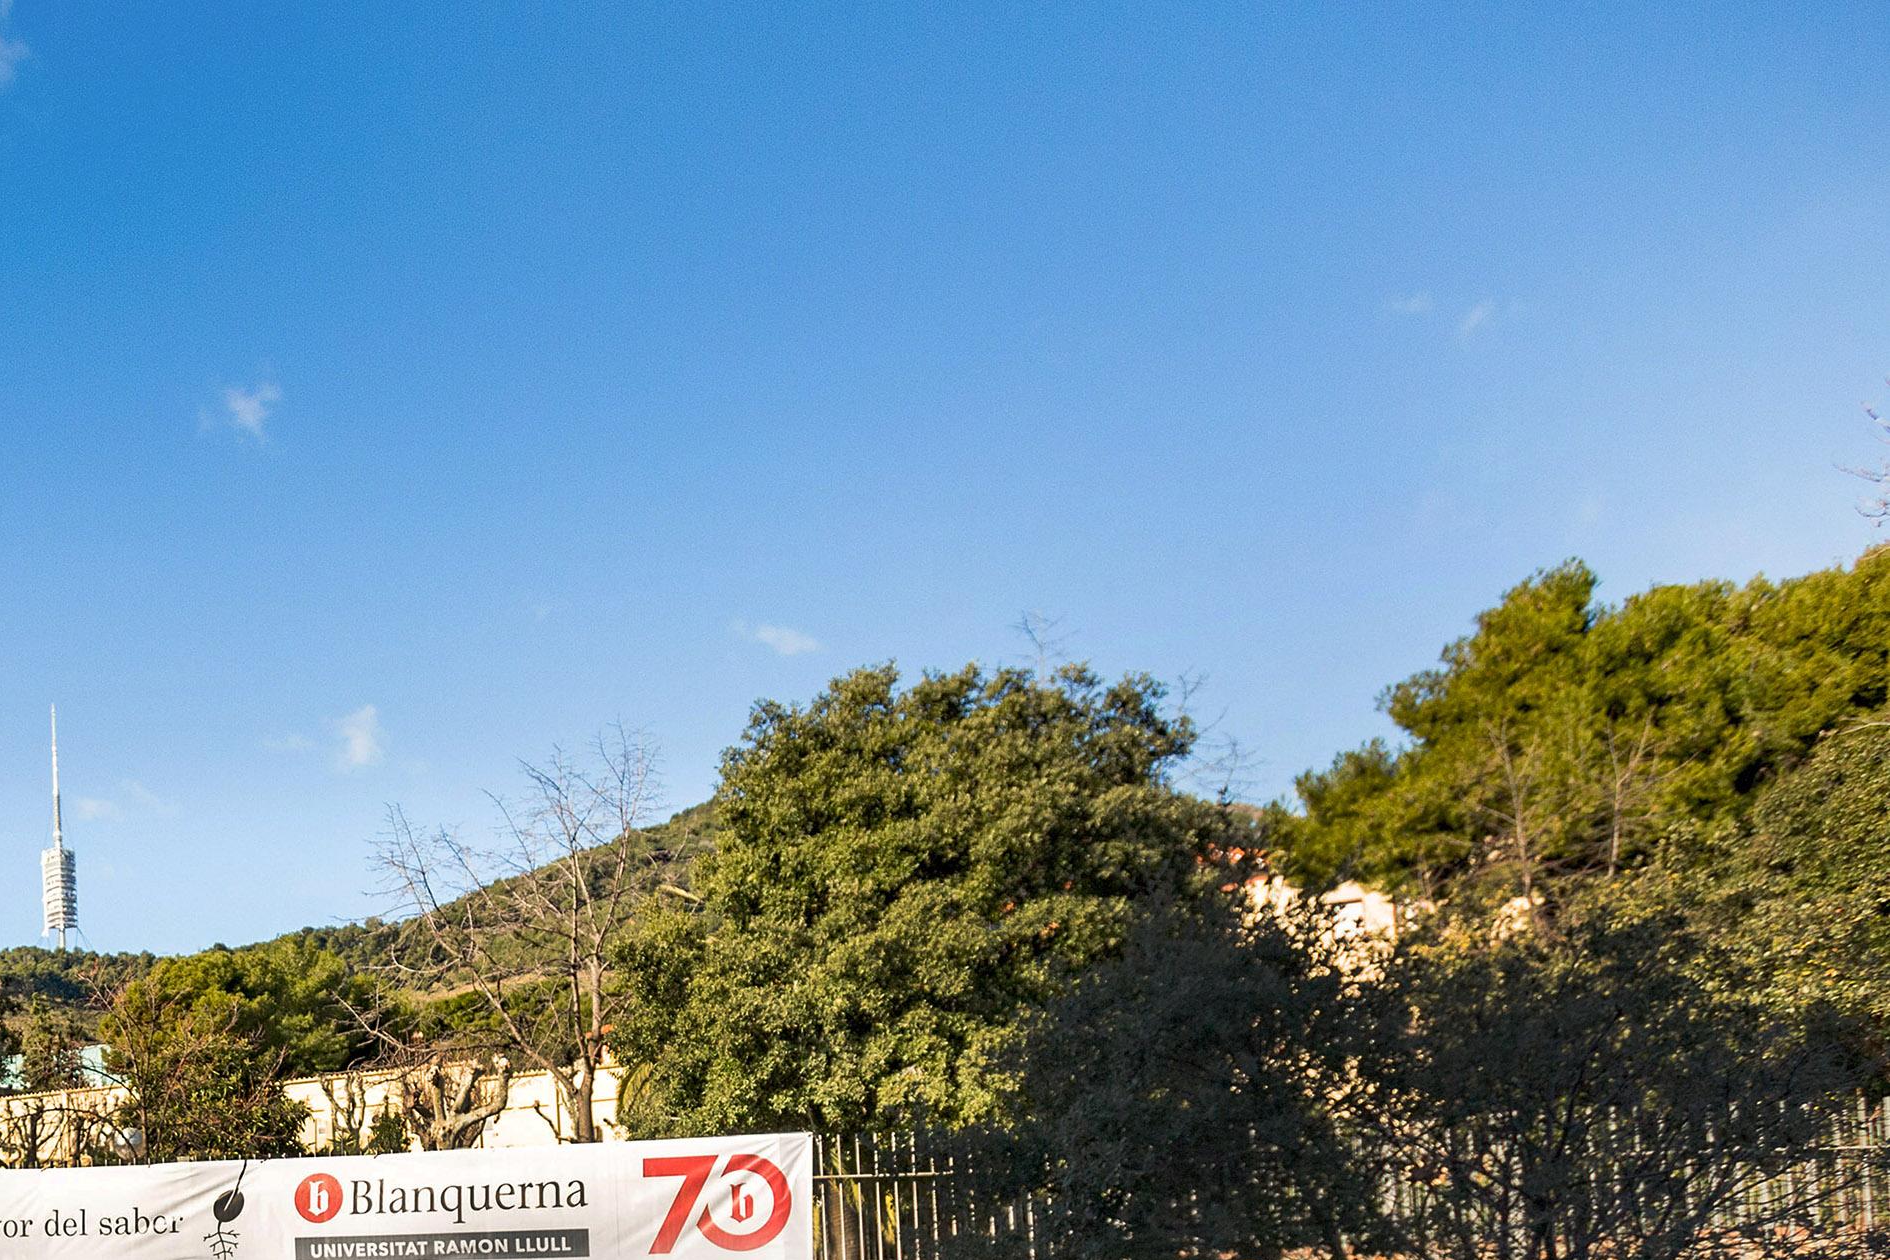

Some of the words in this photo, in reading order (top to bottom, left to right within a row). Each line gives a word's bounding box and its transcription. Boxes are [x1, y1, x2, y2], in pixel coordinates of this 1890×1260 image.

[349, 1178, 589, 1223] Blanquerna
[643, 1154, 792, 1254] 70
[44, 1208, 88, 1237] del
[99, 1207, 184, 1236] sabor
[310, 1241, 428, 1259] UNIVERSITAT
[434, 1237, 508, 1256] RAMON
[515, 1235, 572, 1254] LLULL
